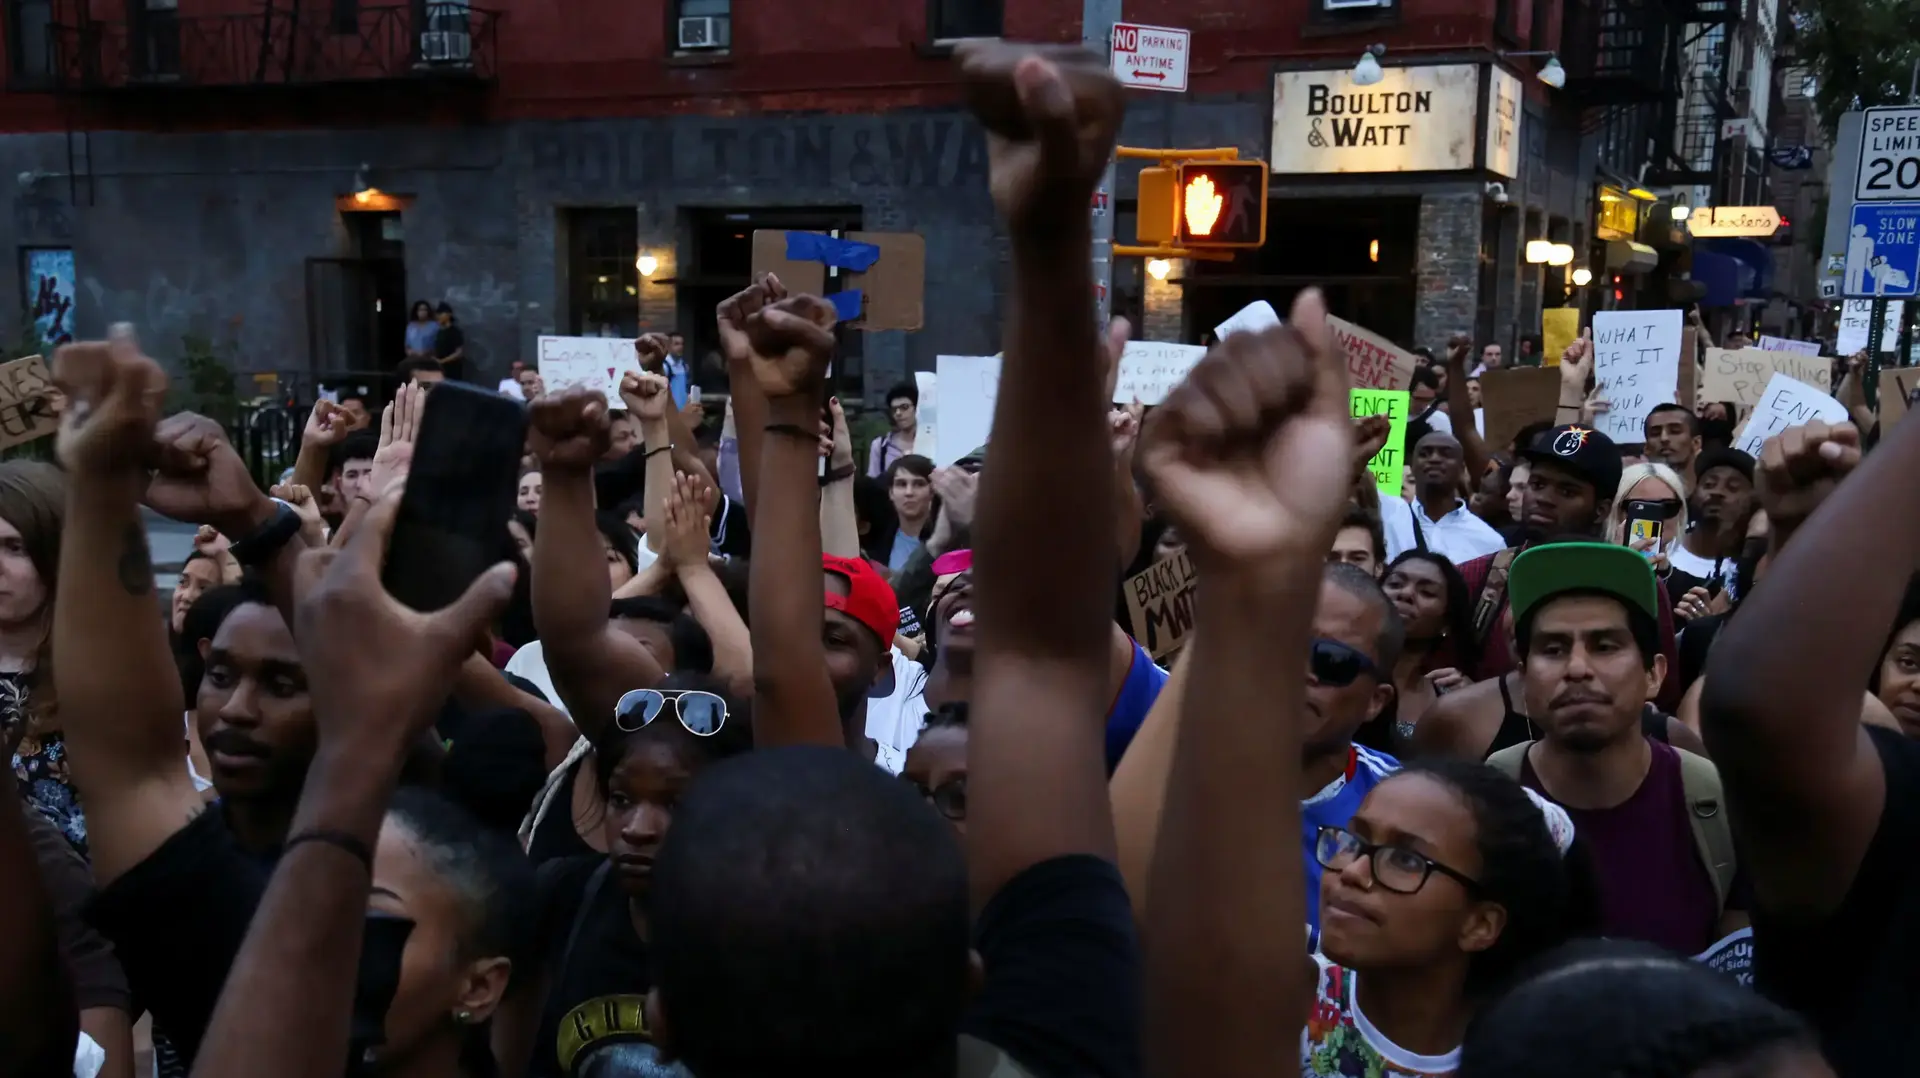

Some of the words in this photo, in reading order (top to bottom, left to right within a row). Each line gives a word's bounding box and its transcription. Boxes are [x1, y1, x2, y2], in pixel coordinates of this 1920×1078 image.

[1115, 28, 1137, 50] NO
[1142, 35, 1182, 51] PARKING
[1126, 54, 1175, 71] ANYTIME
[1307, 84, 1432, 116] BOULTON
[1866, 156, 1920, 190] 20
[1879, 217, 1917, 231] SLOW
[1876, 232, 1916, 245] ZONE
[1597, 325, 1656, 345] WHAT
[1598, 351, 1621, 368] IF
[1635, 347, 1664, 365] IT
[1718, 353, 1765, 382] Stop
[1352, 396, 1399, 419] ENCE
[1608, 393, 1643, 411] OUR
[1133, 558, 1180, 608] BLACK
